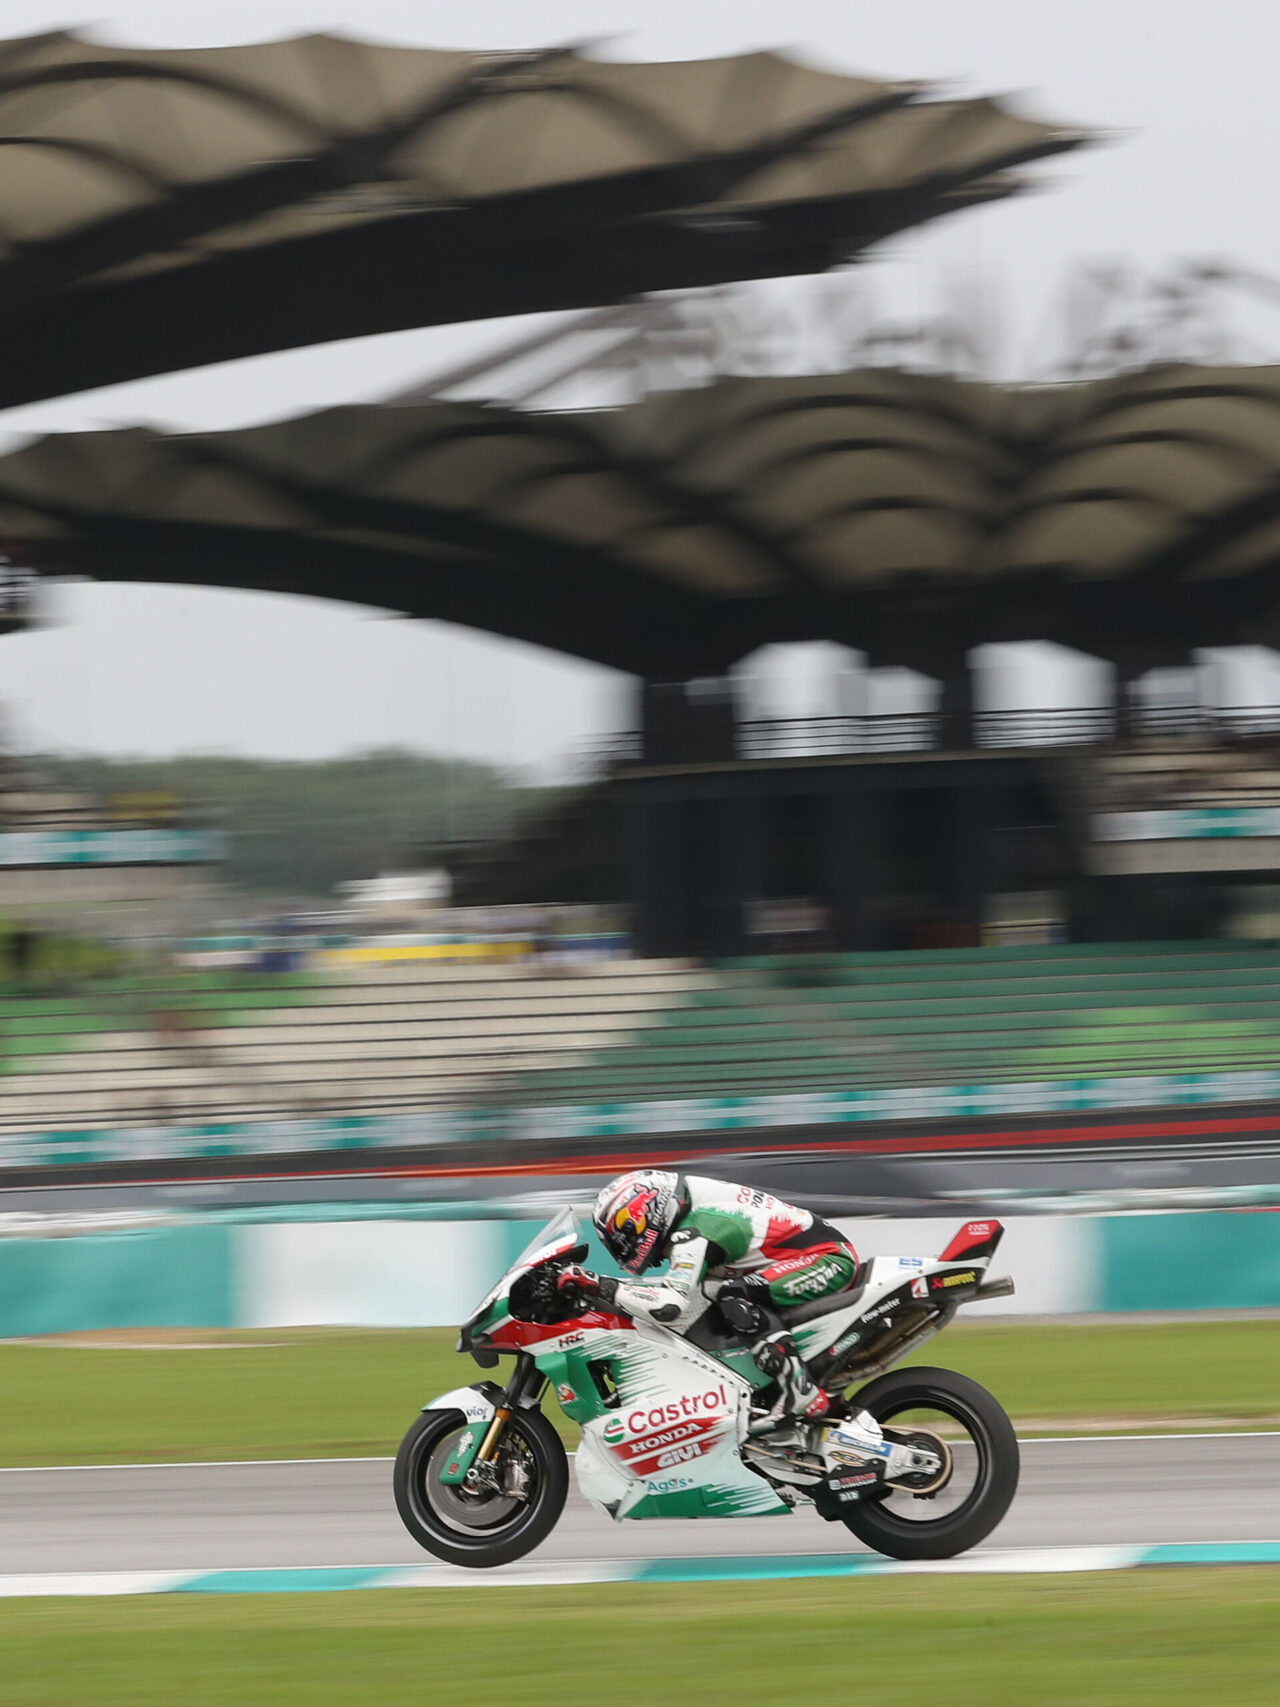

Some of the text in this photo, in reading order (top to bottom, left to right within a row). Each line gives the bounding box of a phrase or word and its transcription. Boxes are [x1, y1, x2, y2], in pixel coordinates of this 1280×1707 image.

[628, 1245, 648, 1269] Red
[638, 1228, 659, 1254] Bull
[861, 1298, 900, 1324] flow-meter
[559, 1332, 585, 1348] HRC
[628, 1384, 727, 1433] Castrol
[629, 1422, 703, 1454] HONDA
[656, 1442, 703, 1468] GIVI
[648, 1478, 688, 1492] Agos
